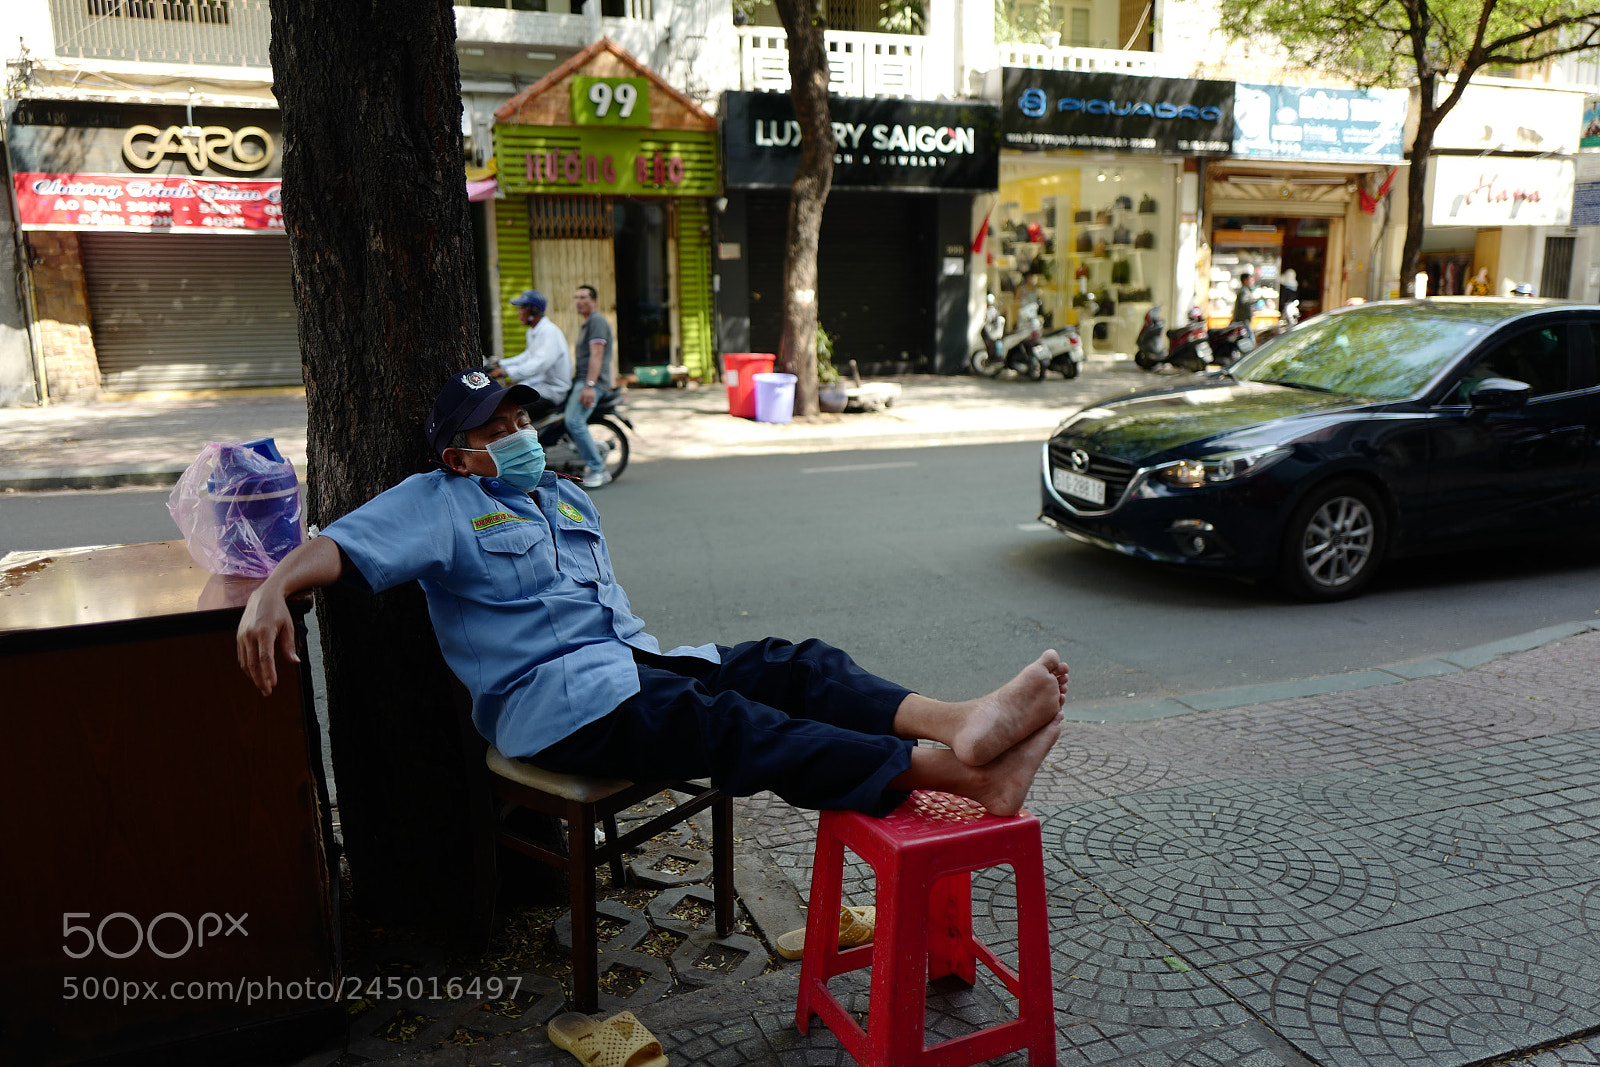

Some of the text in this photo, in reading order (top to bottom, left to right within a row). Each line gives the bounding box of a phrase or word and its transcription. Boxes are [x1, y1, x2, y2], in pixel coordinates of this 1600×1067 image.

[589, 82, 637, 117] 99
[1057, 97, 1223, 121] PIQUADRO
[755, 119, 866, 149] LUXRY
[872, 124, 975, 154] SAIGON
